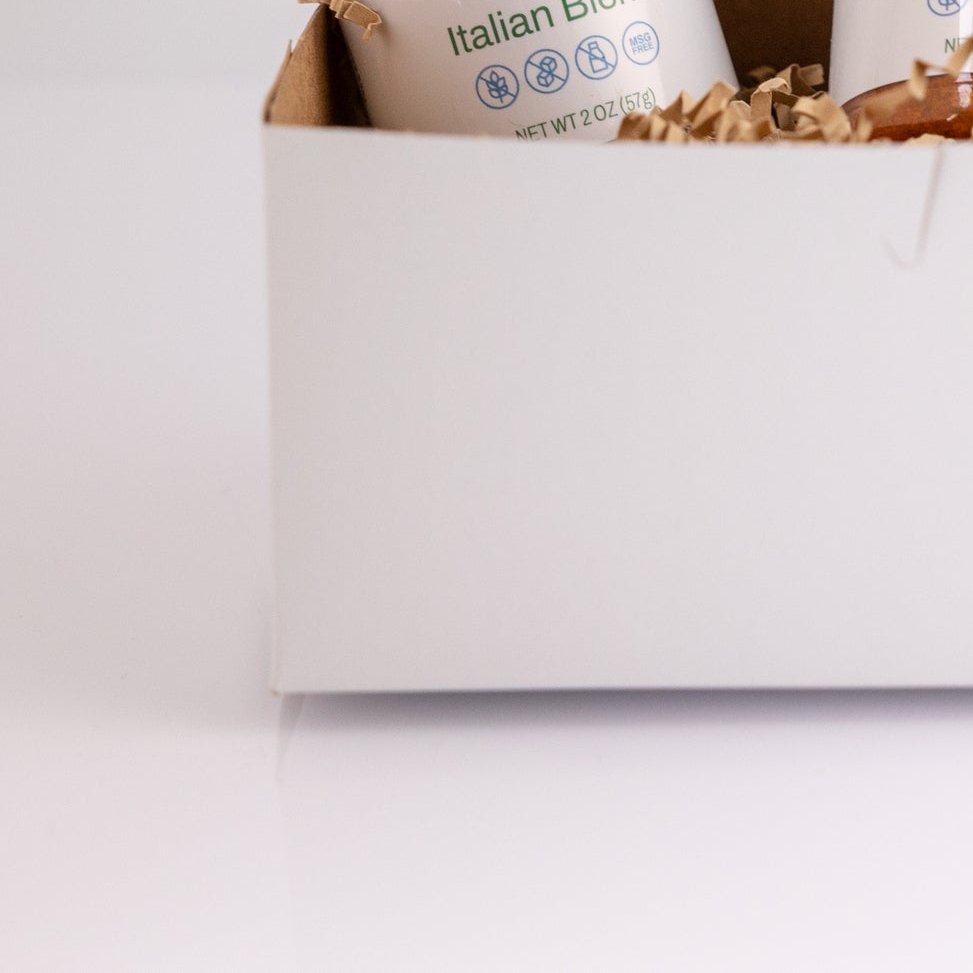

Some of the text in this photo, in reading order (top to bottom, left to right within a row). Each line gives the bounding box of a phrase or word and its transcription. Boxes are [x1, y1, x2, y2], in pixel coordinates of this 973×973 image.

[448, 4, 555, 56] Italian
[629, 32, 652, 47] MSG
[631, 41, 654, 55] FREE
[551, 113, 577, 134] WT
[580, 109, 592, 126] 2
[594, 101, 618, 121] OZ
[620, 87, 656, 115] (57g)
